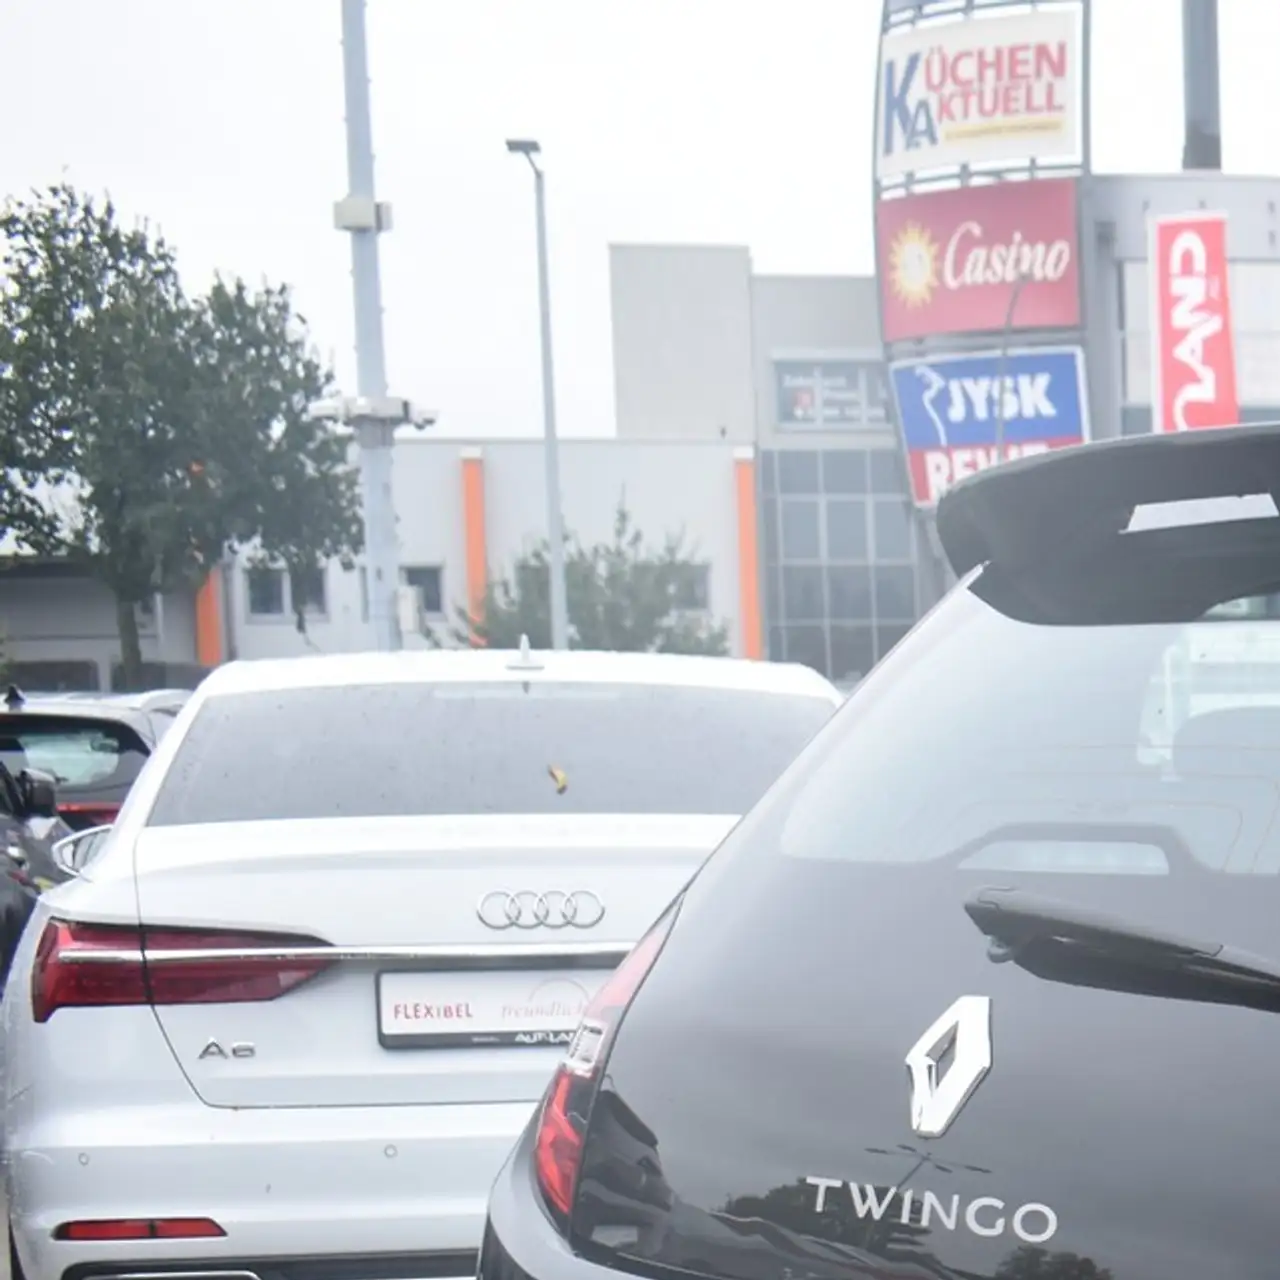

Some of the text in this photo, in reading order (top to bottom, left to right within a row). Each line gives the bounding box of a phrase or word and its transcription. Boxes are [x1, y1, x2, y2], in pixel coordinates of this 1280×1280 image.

[884, 42, 1067, 157] KÜCHEN
[905, 82, 1064, 150] AKTUELL
[943, 220, 1070, 290] Casino
[947, 372, 1057, 424] JYSK
[925, 441, 1050, 501] RE
[393, 1003, 474, 1020] FLEXIBEL
[198, 1037, 257, 1061] A6
[805, 1175, 1058, 1243] TWINGO
